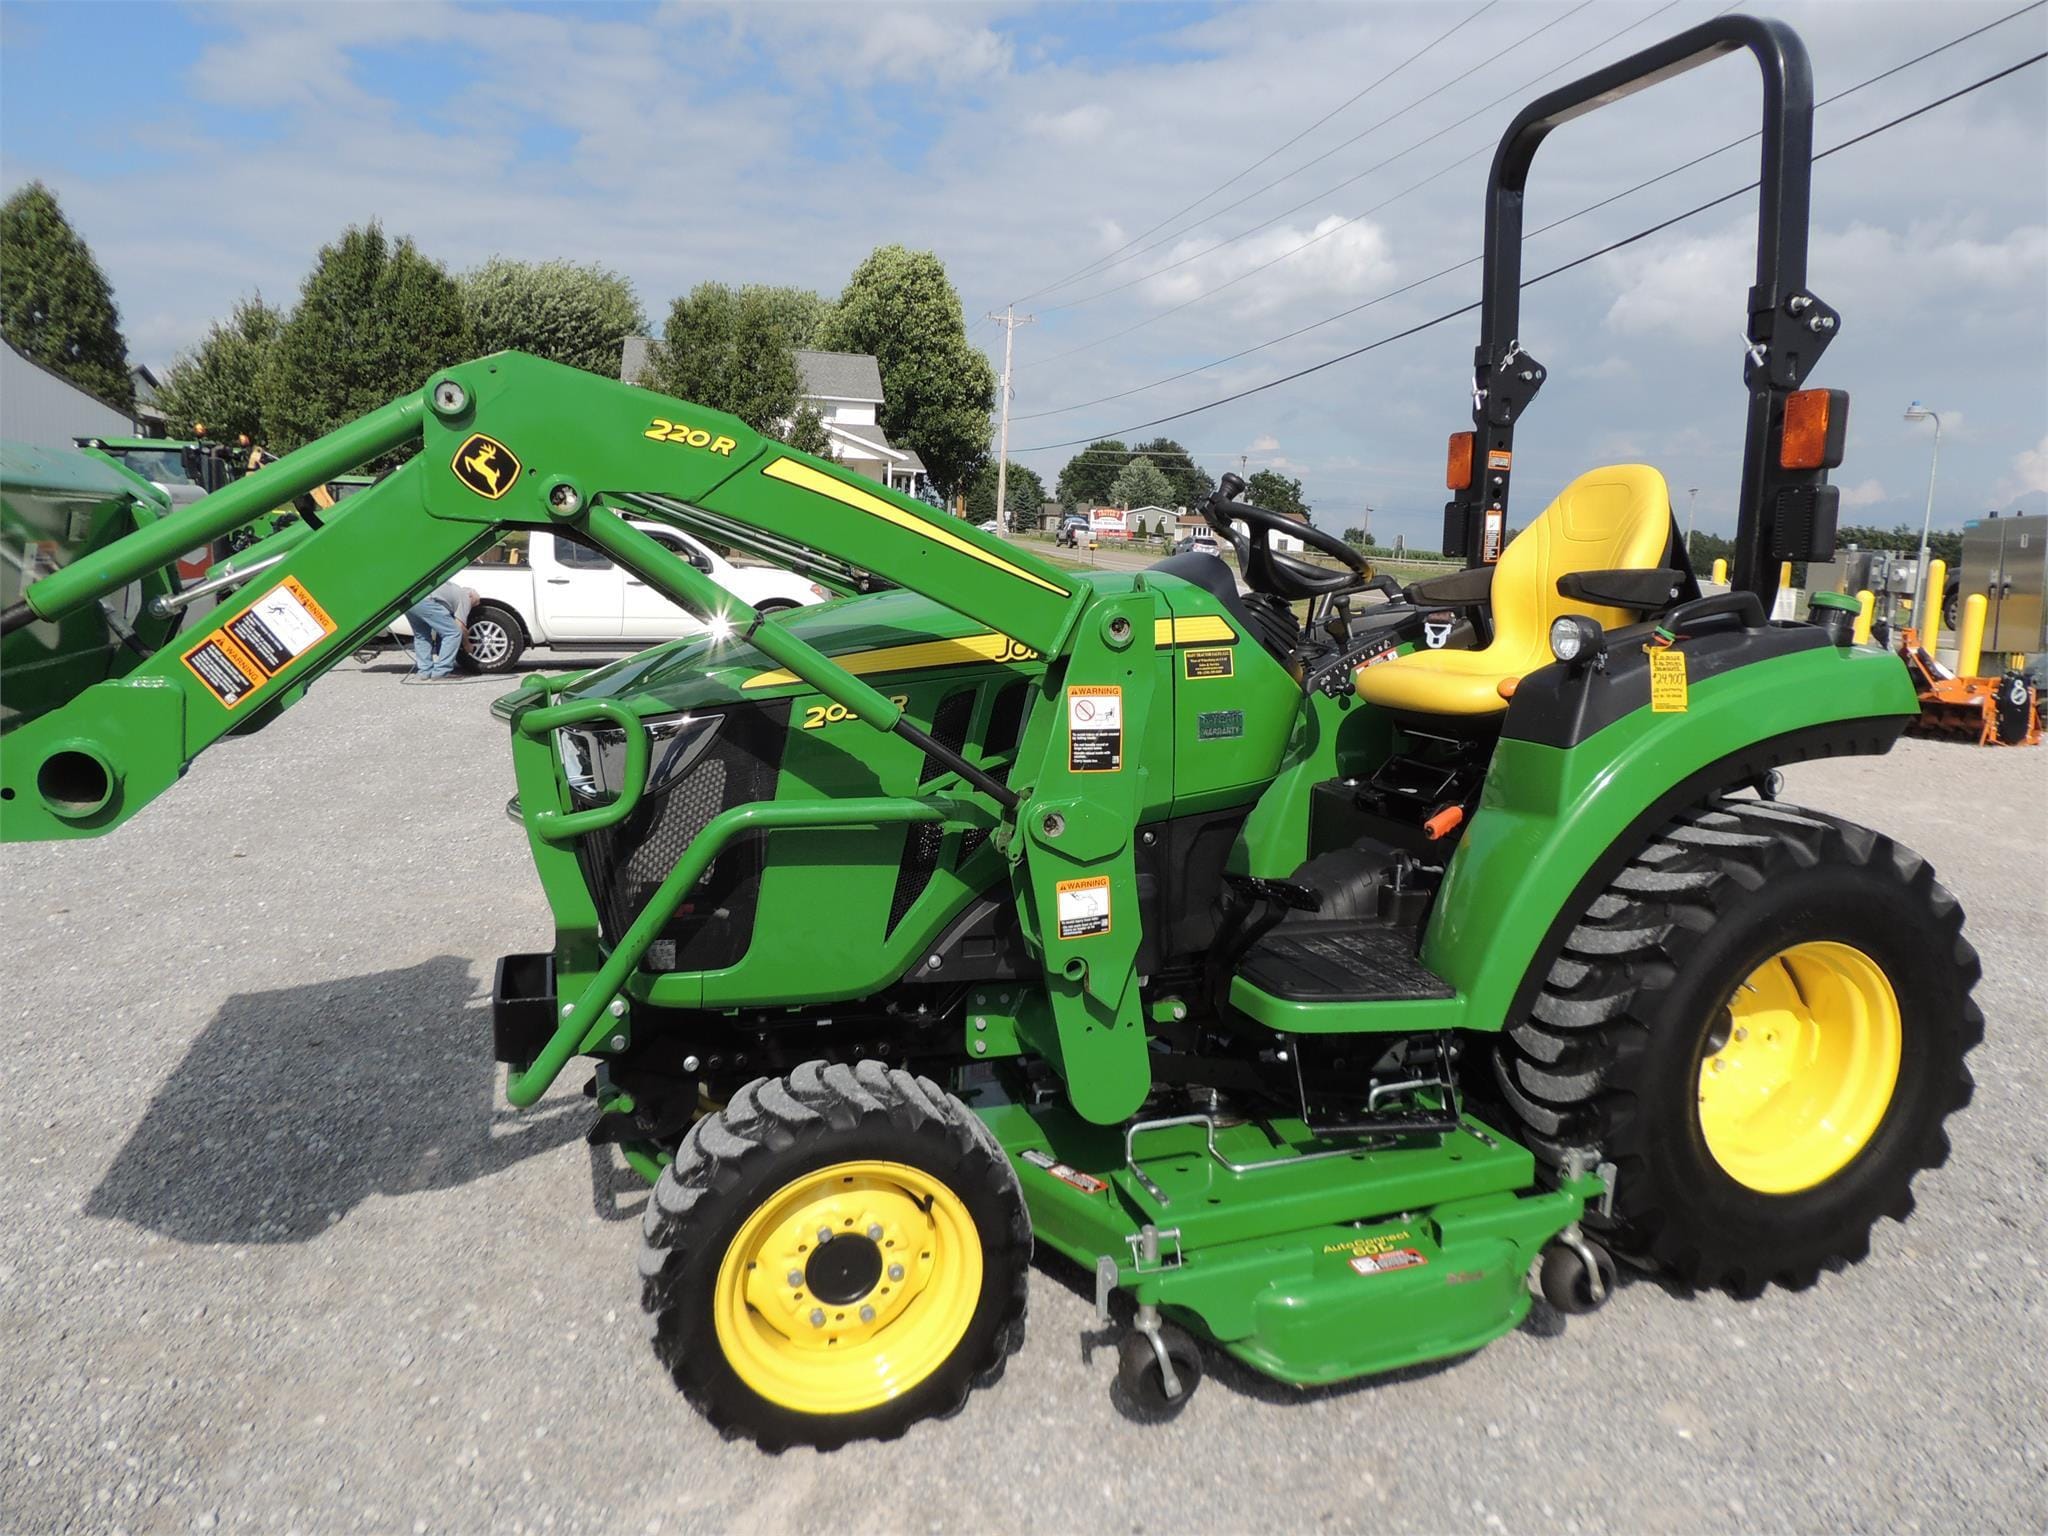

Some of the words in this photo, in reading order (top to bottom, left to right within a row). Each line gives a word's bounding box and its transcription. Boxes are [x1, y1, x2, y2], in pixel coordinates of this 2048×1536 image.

[298, 590, 330, 627] WARNING
[994, 636, 1038, 663] JO
[226, 645, 260, 682] WARNING
[1078, 687, 1119, 695] WARNING
[1067, 878, 1107, 890] WARNING
[1323, 1230, 1411, 1254] AutoConnect
